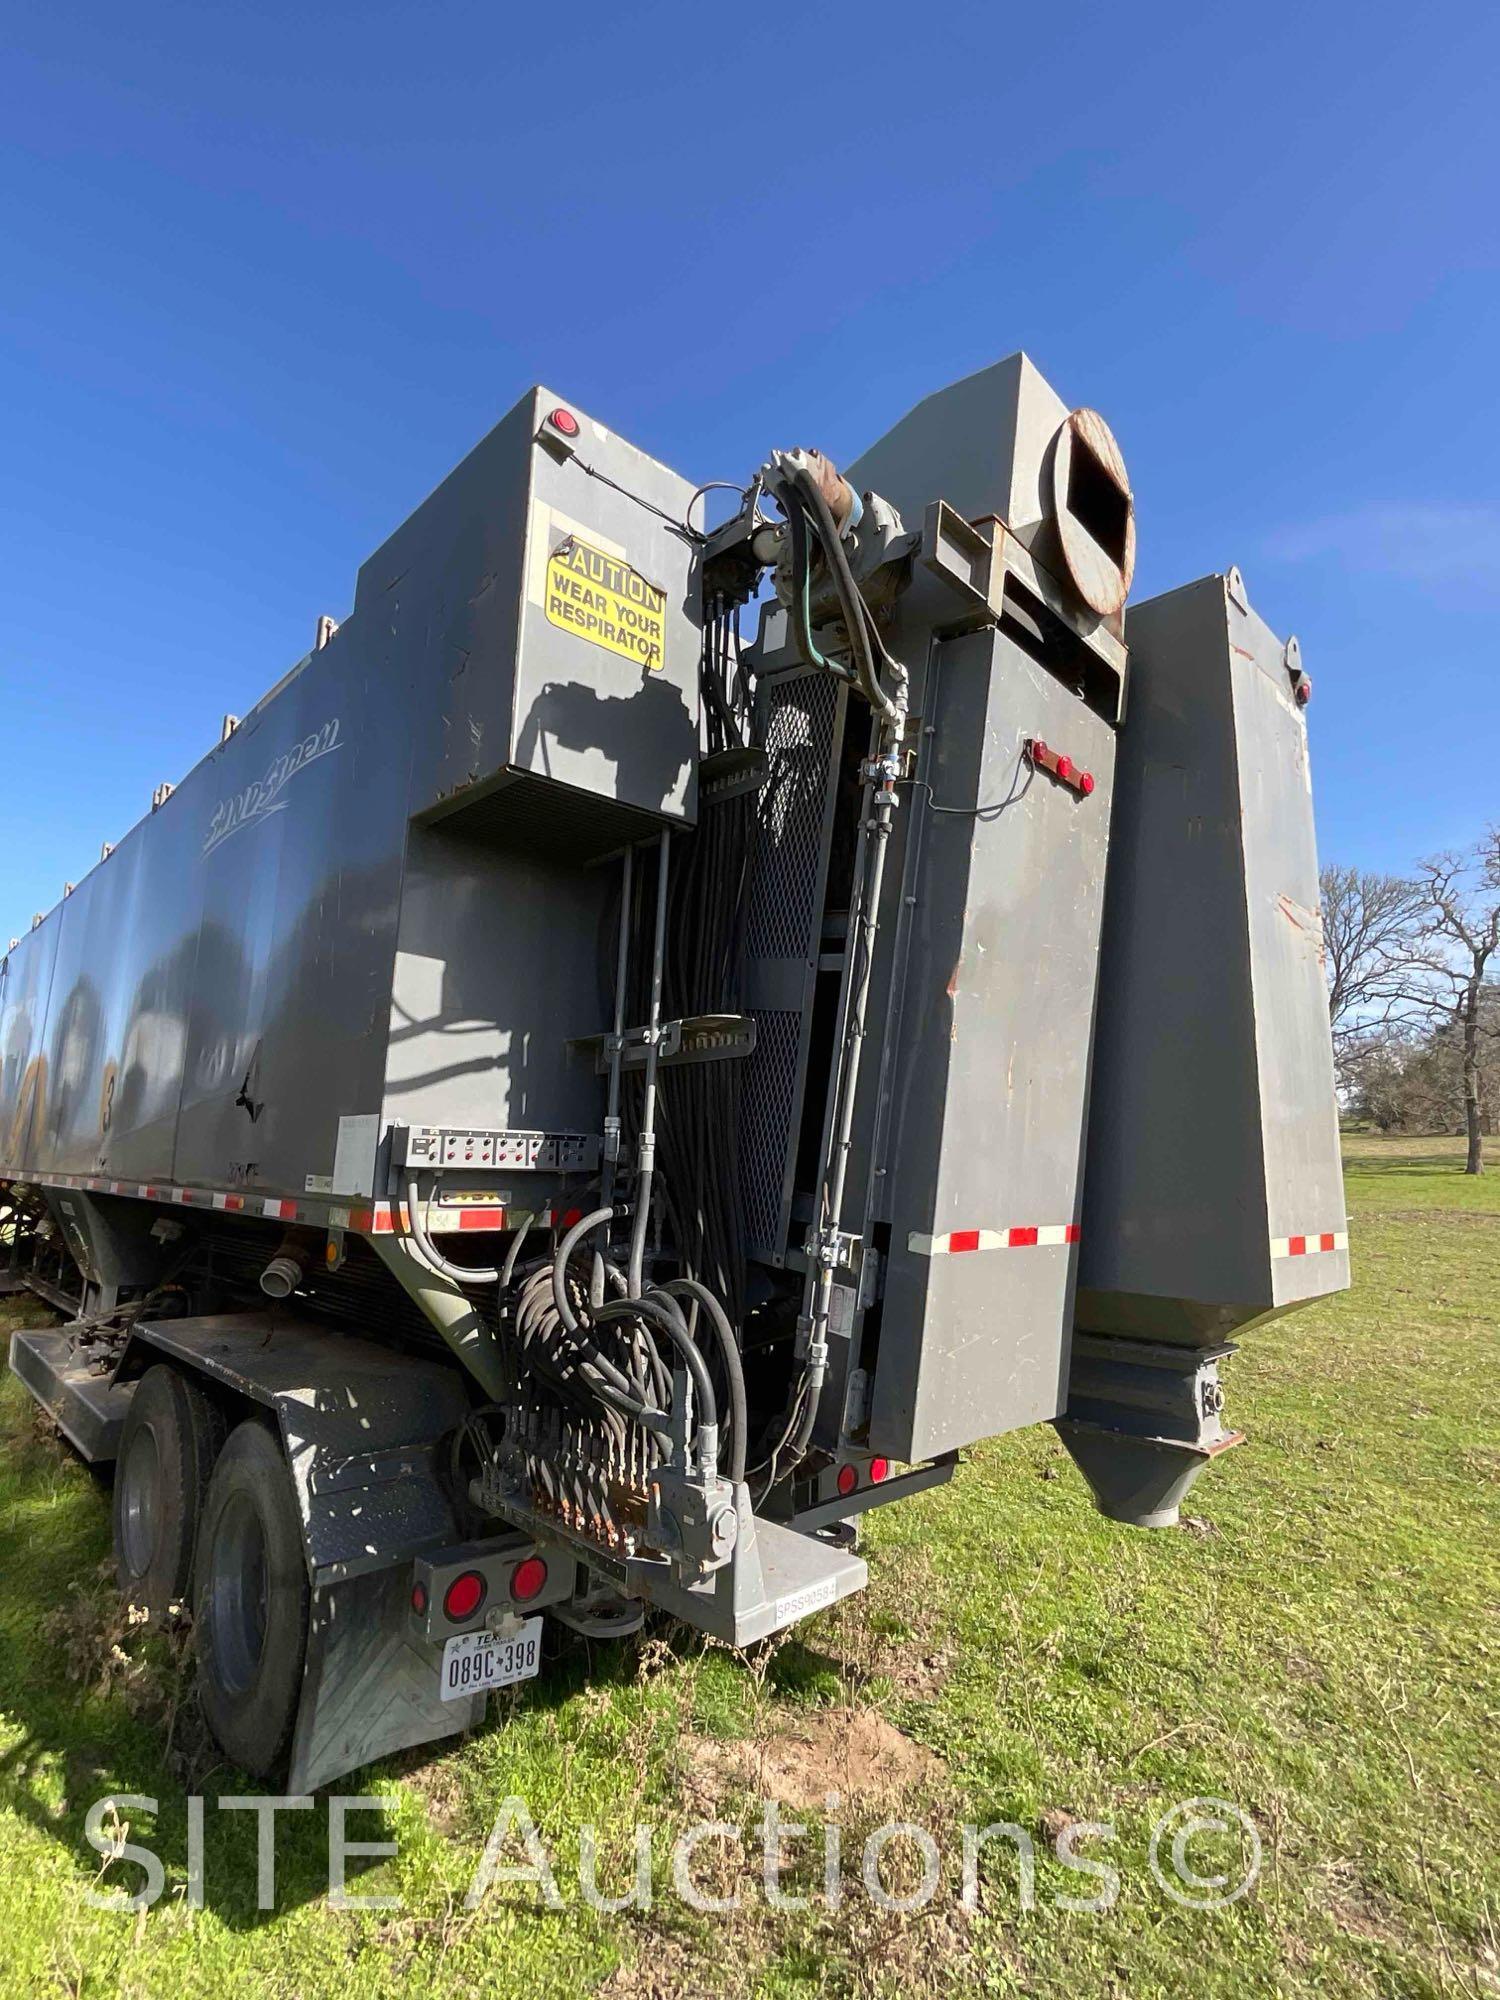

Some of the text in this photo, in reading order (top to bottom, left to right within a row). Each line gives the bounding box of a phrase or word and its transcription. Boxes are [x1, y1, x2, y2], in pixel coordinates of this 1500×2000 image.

[550, 594, 661, 662] RESPIRATOR
[553, 571, 660, 640] WEAR YOUR
[449, 1650, 494, 1687] 089C
[505, 1640, 535, 1673] 398
[476, 1633, 502, 1645] TEX
